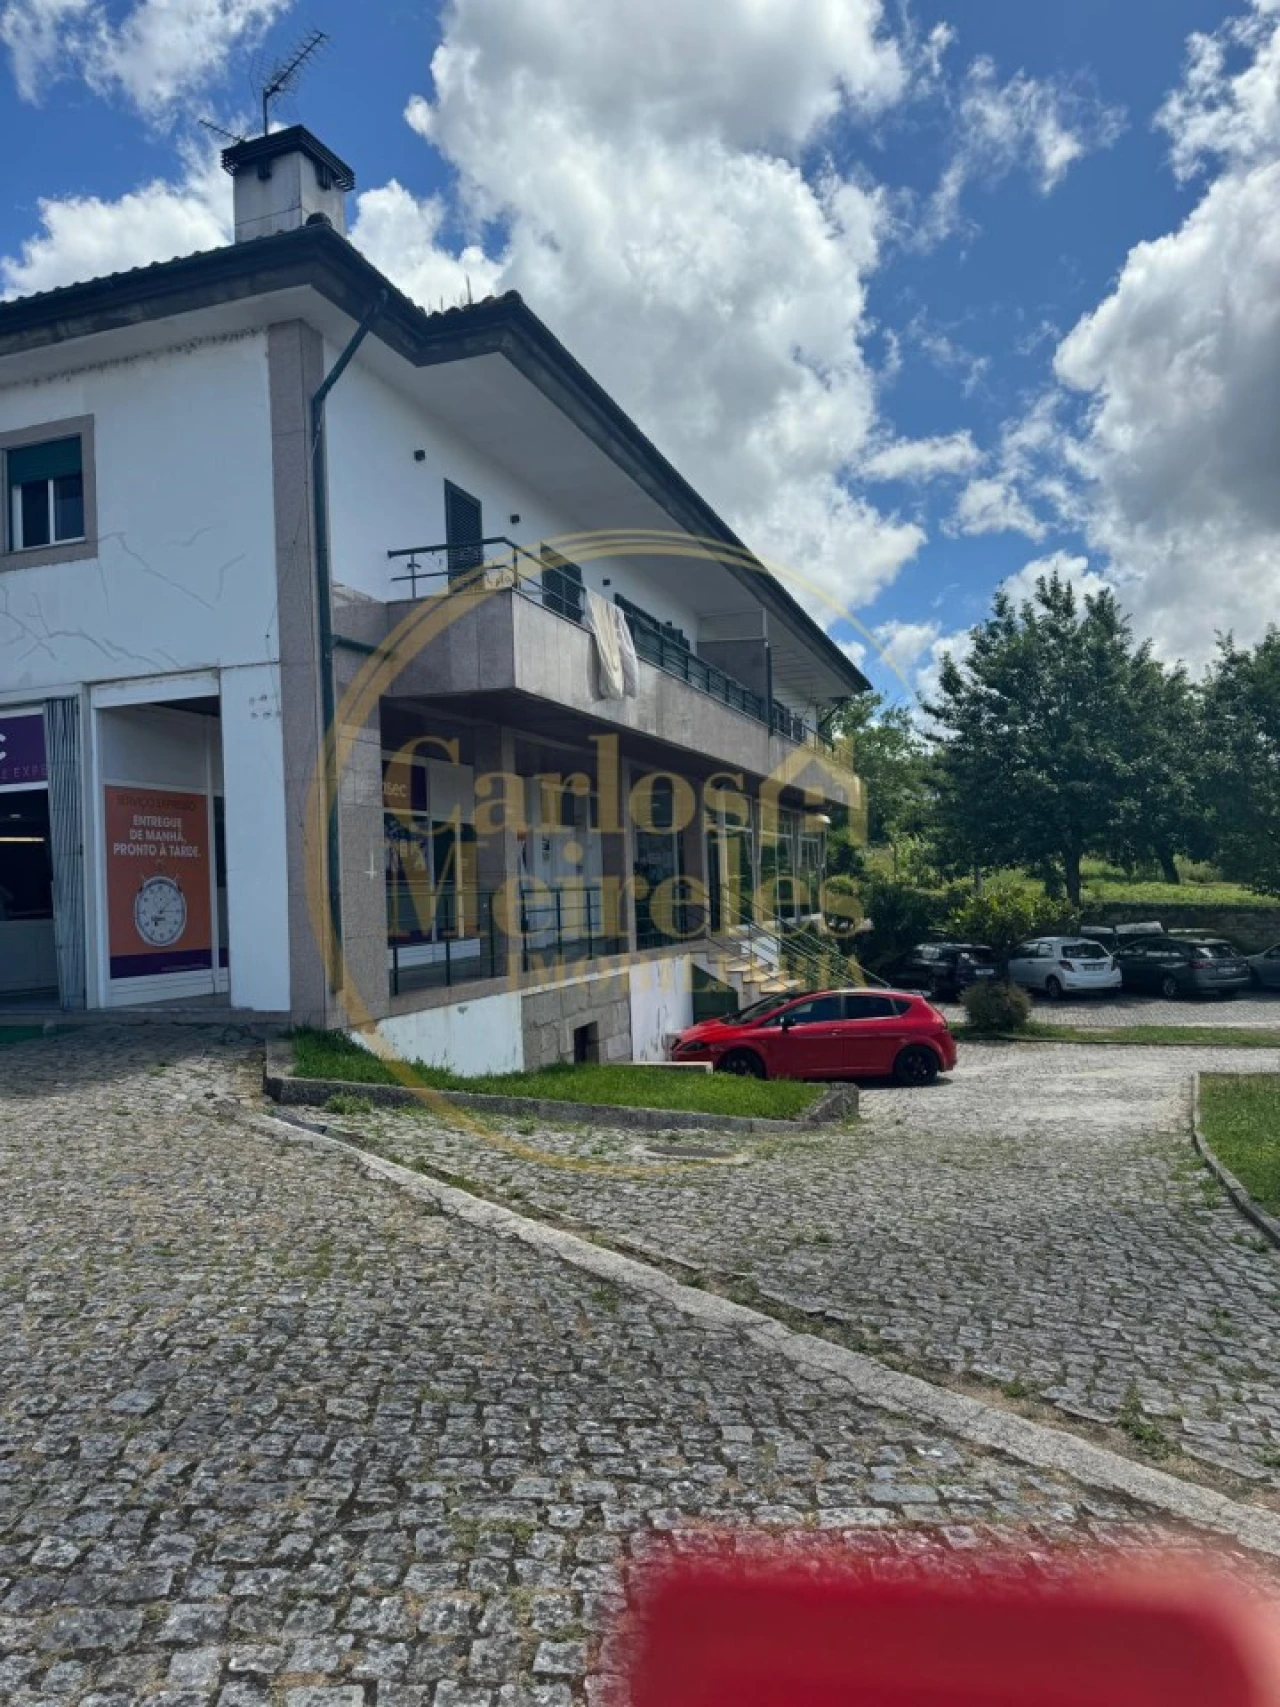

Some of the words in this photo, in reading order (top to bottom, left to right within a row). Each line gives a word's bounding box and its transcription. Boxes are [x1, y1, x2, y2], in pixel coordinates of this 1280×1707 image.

[133, 813, 183, 828] ENTREGUE
[130, 828, 144, 840] DE
[113, 842, 158, 856] PRONTO
